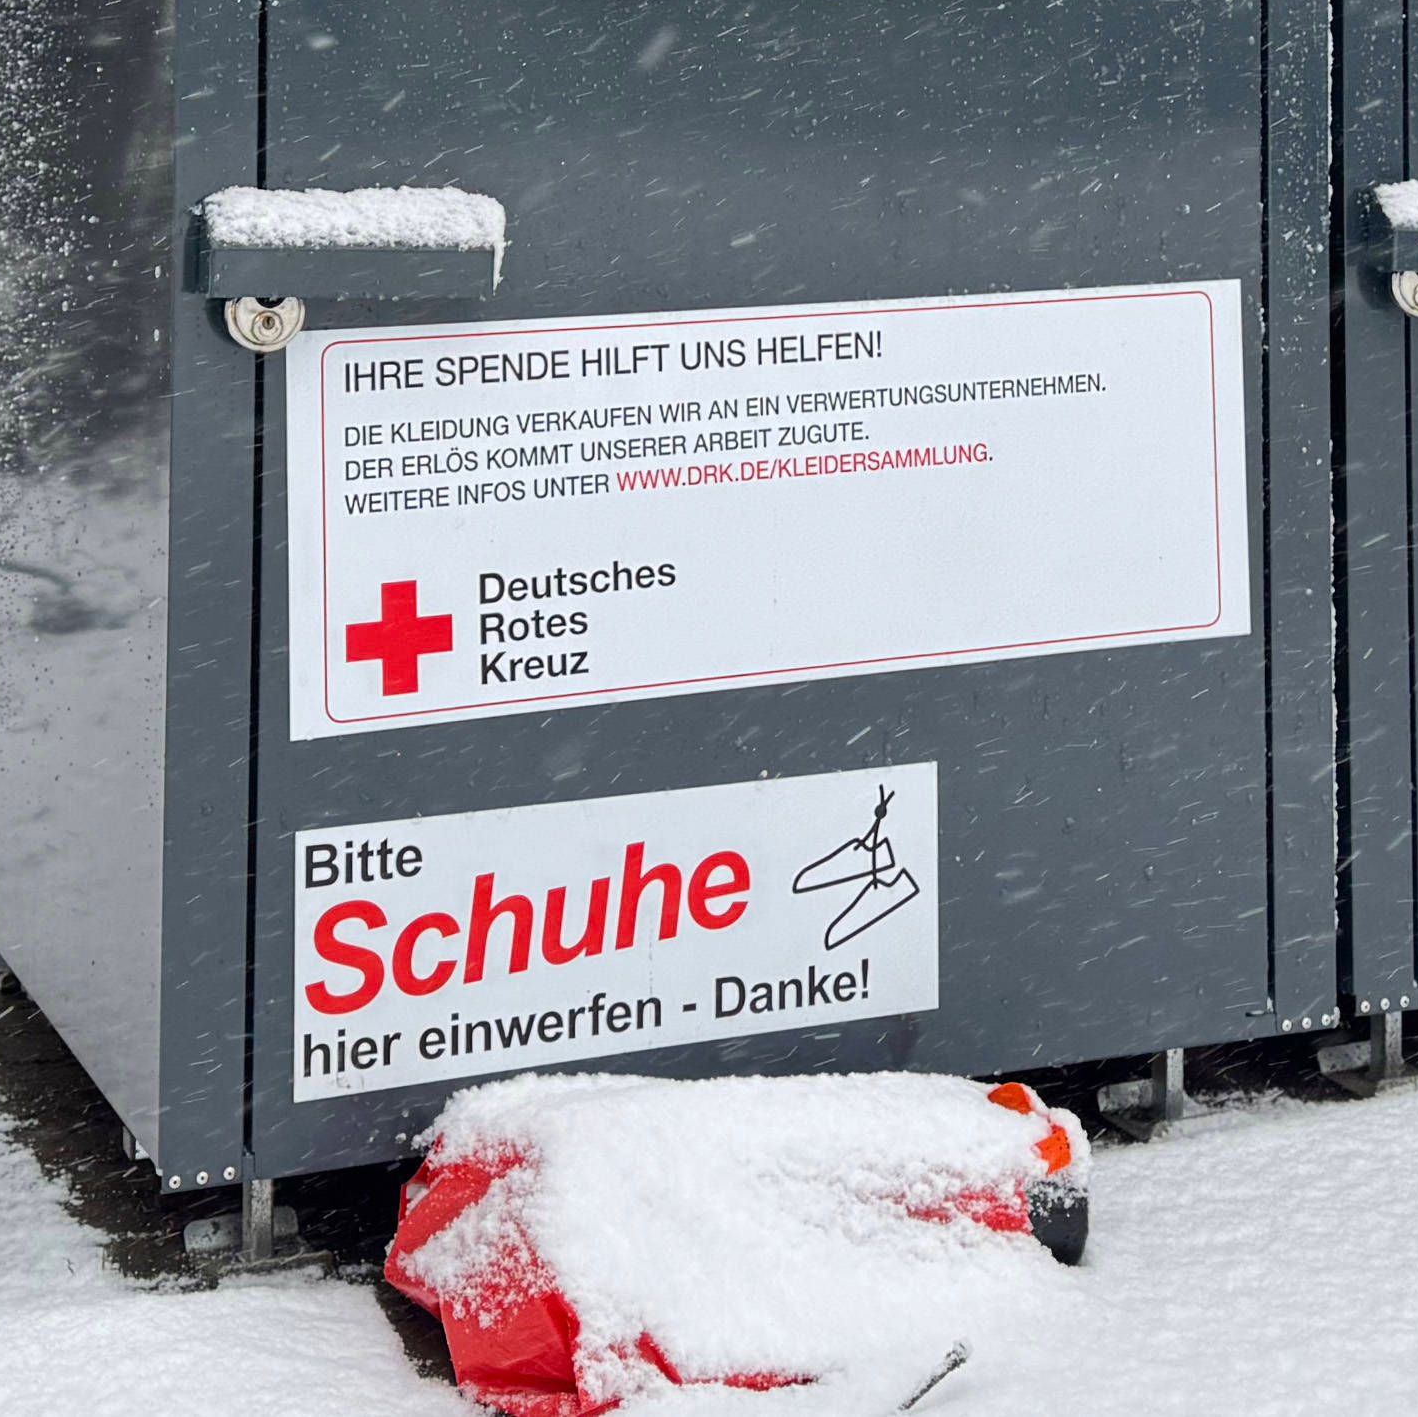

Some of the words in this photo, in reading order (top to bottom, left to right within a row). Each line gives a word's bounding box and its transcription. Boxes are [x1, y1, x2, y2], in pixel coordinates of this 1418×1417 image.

[343, 358, 425, 393] IHRE
[434, 350, 571, 387] SPENDE
[581, 343, 671, 377] HILFT
[680, 339, 746, 370] UNS
[756, 330, 883, 366] HELFEN!
[344, 424, 383, 447] DIE
[390, 415, 510, 444] KLEIDUNG
[516, 405, 652, 434] VERKAUFEN
[659, 401, 702, 424] WIR
[707, 399, 739, 422] AN
[745, 395, 780, 418] EIN
[786, 372, 1107, 414] VERWERTUNGSUNTERNEHMEN.
[344, 458, 394, 482] DER
[402, 446, 479, 477] ERLÖS
[486, 443, 574, 471] KOMMT
[580, 434, 687, 463] UNSERER
[693, 428, 772, 454] ARBEIT
[778, 421, 870, 447] ZUGUTE.
[344, 486, 450, 515] WEITERE
[457, 480, 526, 506] INFOS
[533, 473, 609, 500] UNTER
[616, 443, 994, 492] WWW.DRK.DE/KLEIDERSAMMLUNG.
[478, 560, 677, 605] Deutsches
[479, 608, 589, 645] Rotes
[480, 650, 590, 685] Kreuz
[304, 838, 423, 889] Bitte
[304, 840, 751, 1016] Schuhe
[302, 1029, 401, 1078] hier
[417, 992, 663, 1061] einwerfen
[714, 958, 870, 1020] Danke!
